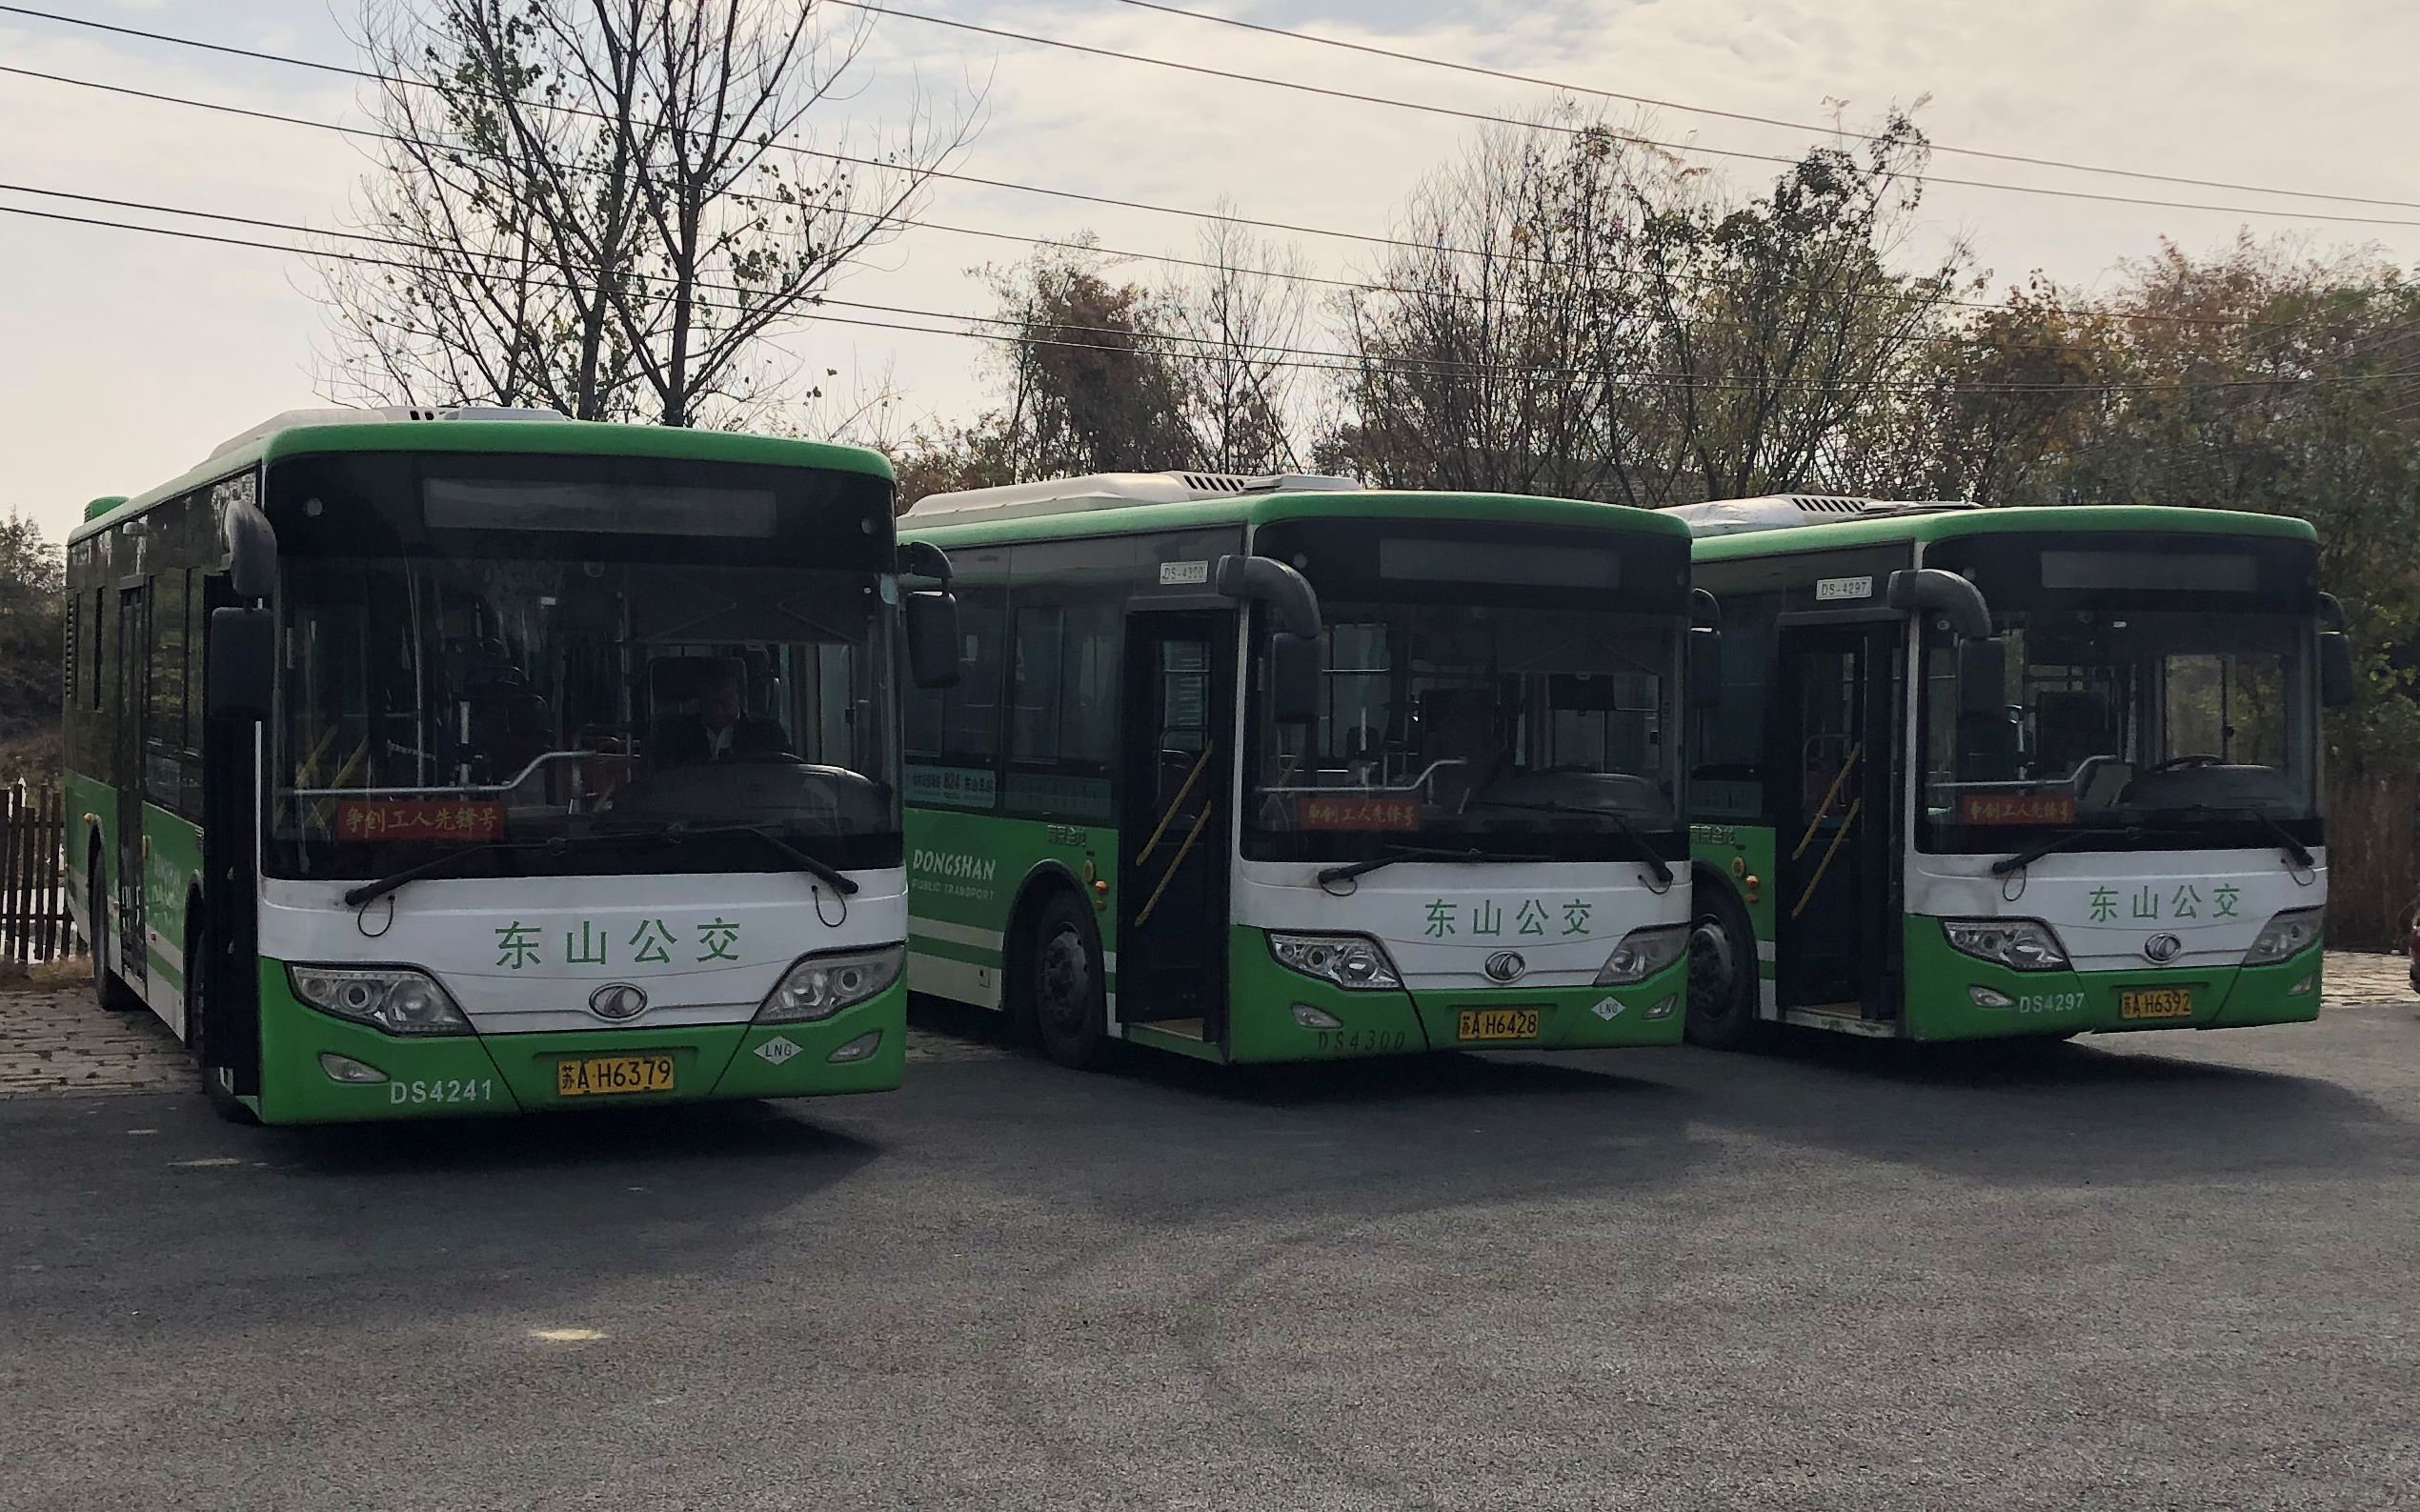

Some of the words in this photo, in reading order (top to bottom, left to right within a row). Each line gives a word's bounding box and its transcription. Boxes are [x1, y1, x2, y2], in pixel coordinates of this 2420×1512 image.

[1821, 581, 1867, 595] DS-4297
[346, 807, 497, 833] 争创工人先锋号
[913, 849, 997, 880] DONGSHAN
[944, 883, 995, 899] TRANSPORT
[2088, 883, 2241, 922] 东山公交
[1424, 898, 1592, 938] 东山公交
[494, 917, 740, 970] 东山公交
[1599, 1002, 1619, 1015] LNG
[2019, 993, 2085, 1013] DS4297
[764, 1043, 792, 1058] LNG
[1318, 1029, 1405, 1051] DS4300
[390, 1079, 492, 1104] DS4241
